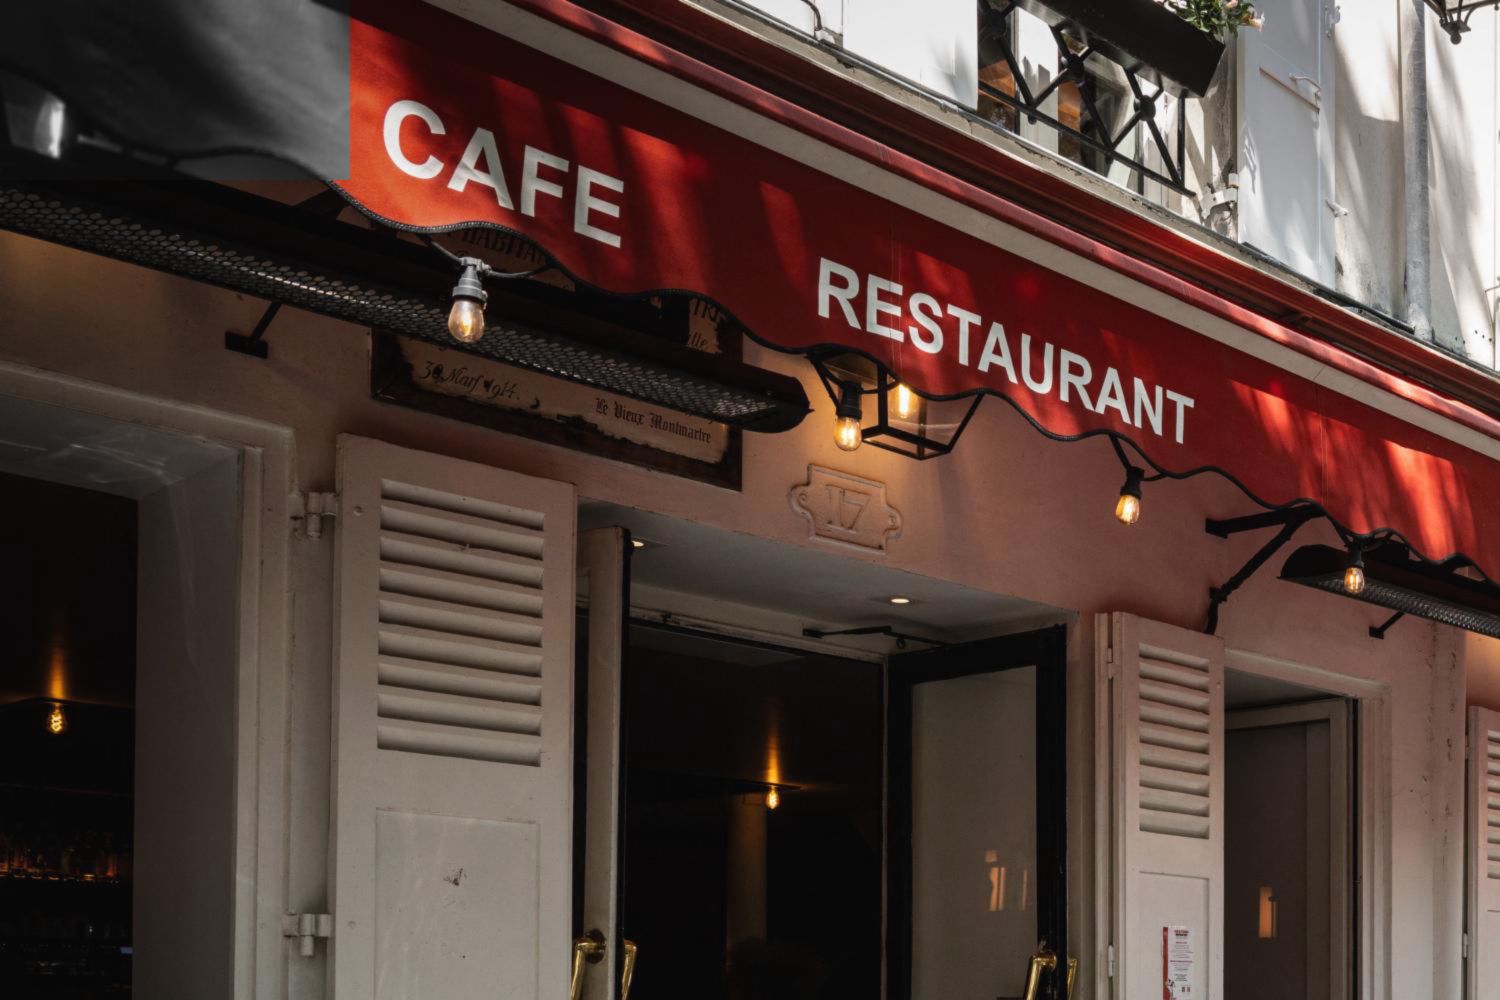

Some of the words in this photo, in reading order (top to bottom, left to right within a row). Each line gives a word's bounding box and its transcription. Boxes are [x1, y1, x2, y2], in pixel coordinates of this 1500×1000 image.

[383, 100, 624, 248] CAFE
[818, 257, 1195, 444] RESTAURANT
[595, 398, 608, 416] Le
[613, 402, 645, 425] Vieux
[650, 412, 712, 444] Montmartre
[825, 484, 872, 534] 17
